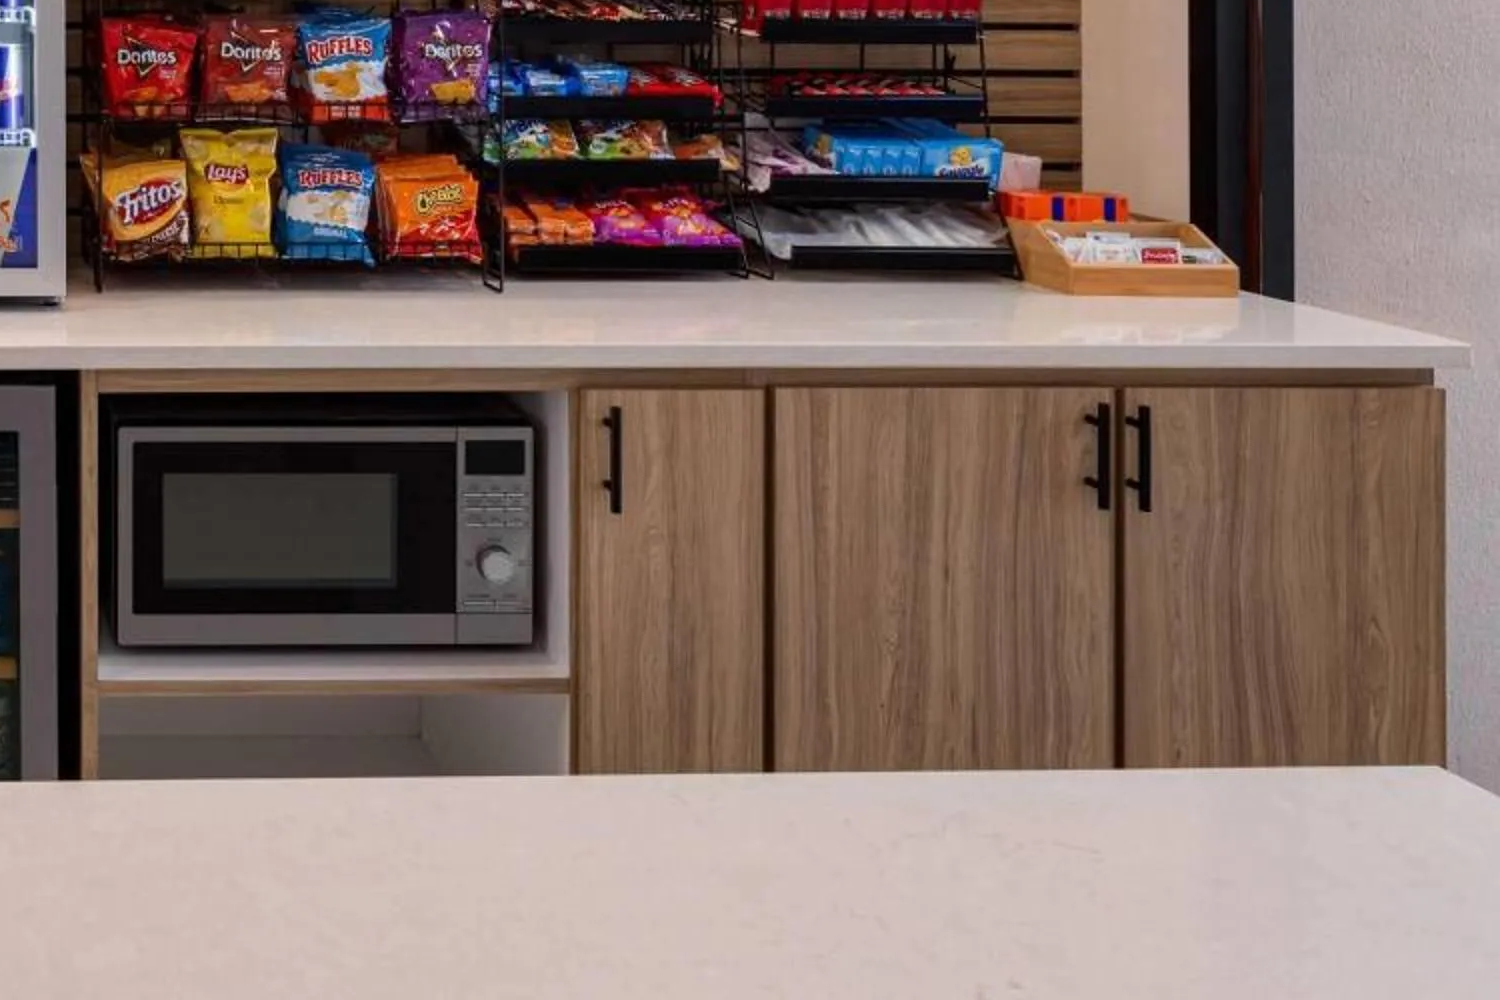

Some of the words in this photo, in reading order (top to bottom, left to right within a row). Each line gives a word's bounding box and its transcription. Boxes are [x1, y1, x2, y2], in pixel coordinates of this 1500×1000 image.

[117, 48, 177, 65] Doritos
[221, 41, 282, 61] Doritos
[307, 36, 373, 64] RUFFLES
[424, 43, 483, 58] Doritos
[207, 164, 247, 184] Lay's
[298, 168, 363, 188] RUFFLES
[116, 180, 185, 225] Fritos
